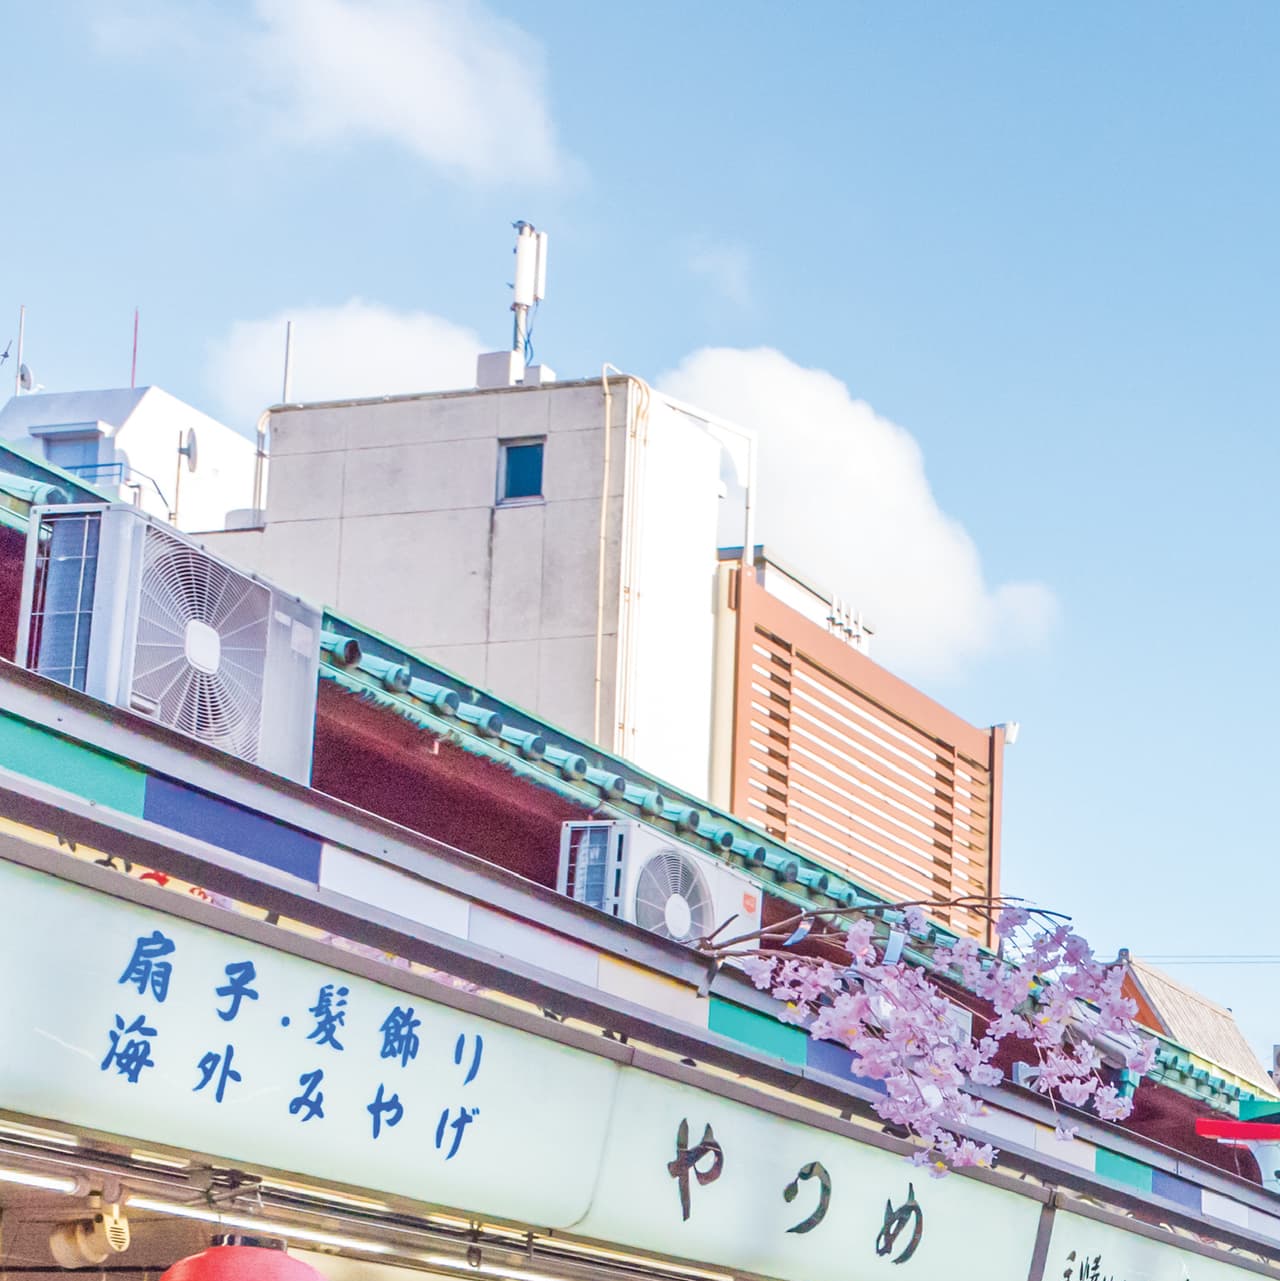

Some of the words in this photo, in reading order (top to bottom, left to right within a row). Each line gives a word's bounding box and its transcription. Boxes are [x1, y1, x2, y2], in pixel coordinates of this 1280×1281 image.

[101, 1013, 481, 1161] 海外みやげ
[666, 1116, 925, 1265] やつめ
